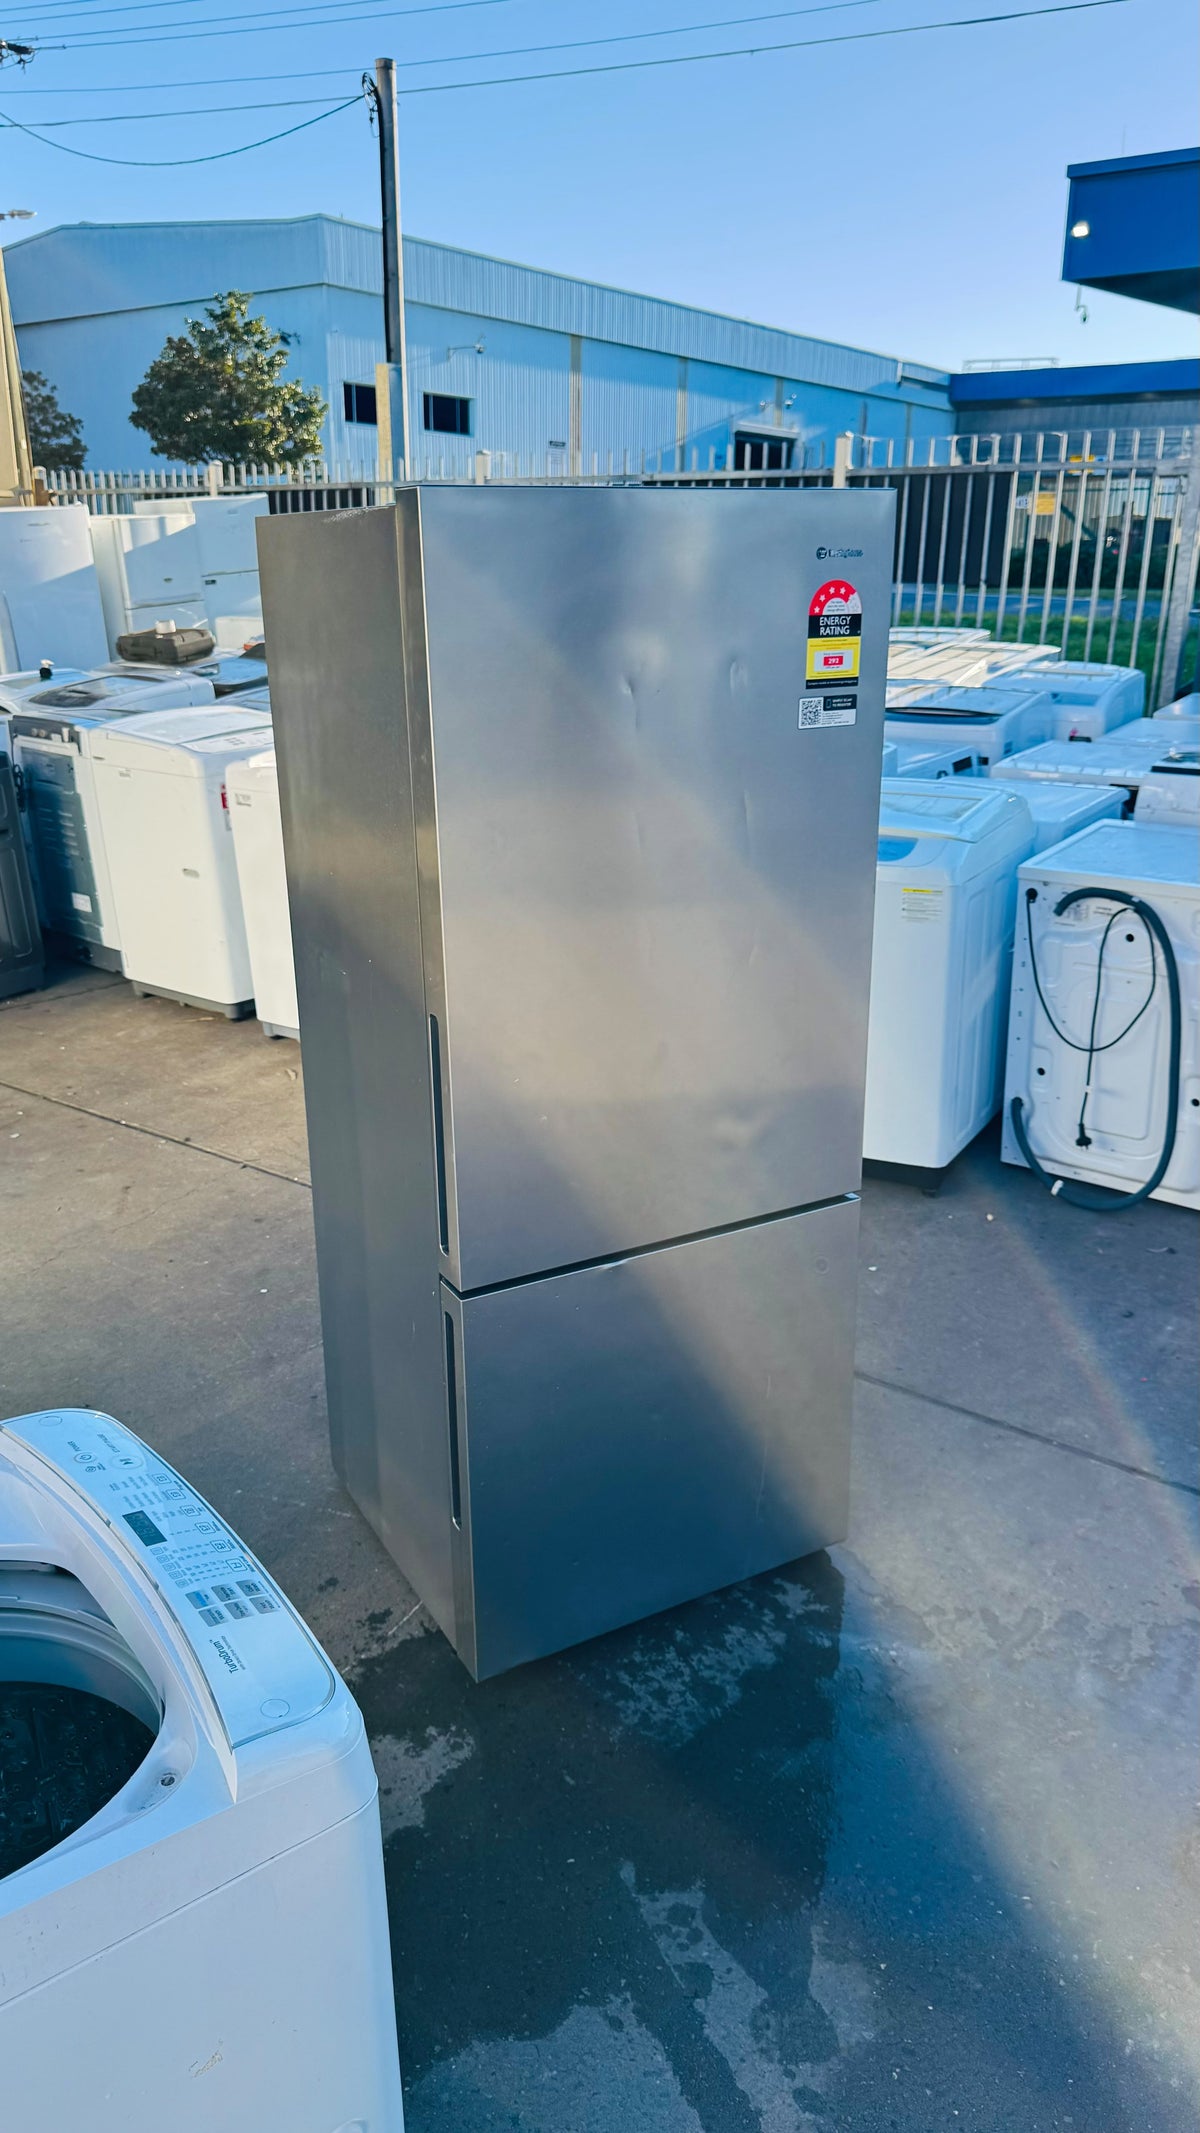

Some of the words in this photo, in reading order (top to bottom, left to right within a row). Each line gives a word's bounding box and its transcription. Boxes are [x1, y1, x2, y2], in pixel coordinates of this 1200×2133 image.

[819, 616, 852, 626] ENERGY
[819, 626, 850, 636] RATING
[212, 1640, 239, 1674] TurboDrum
